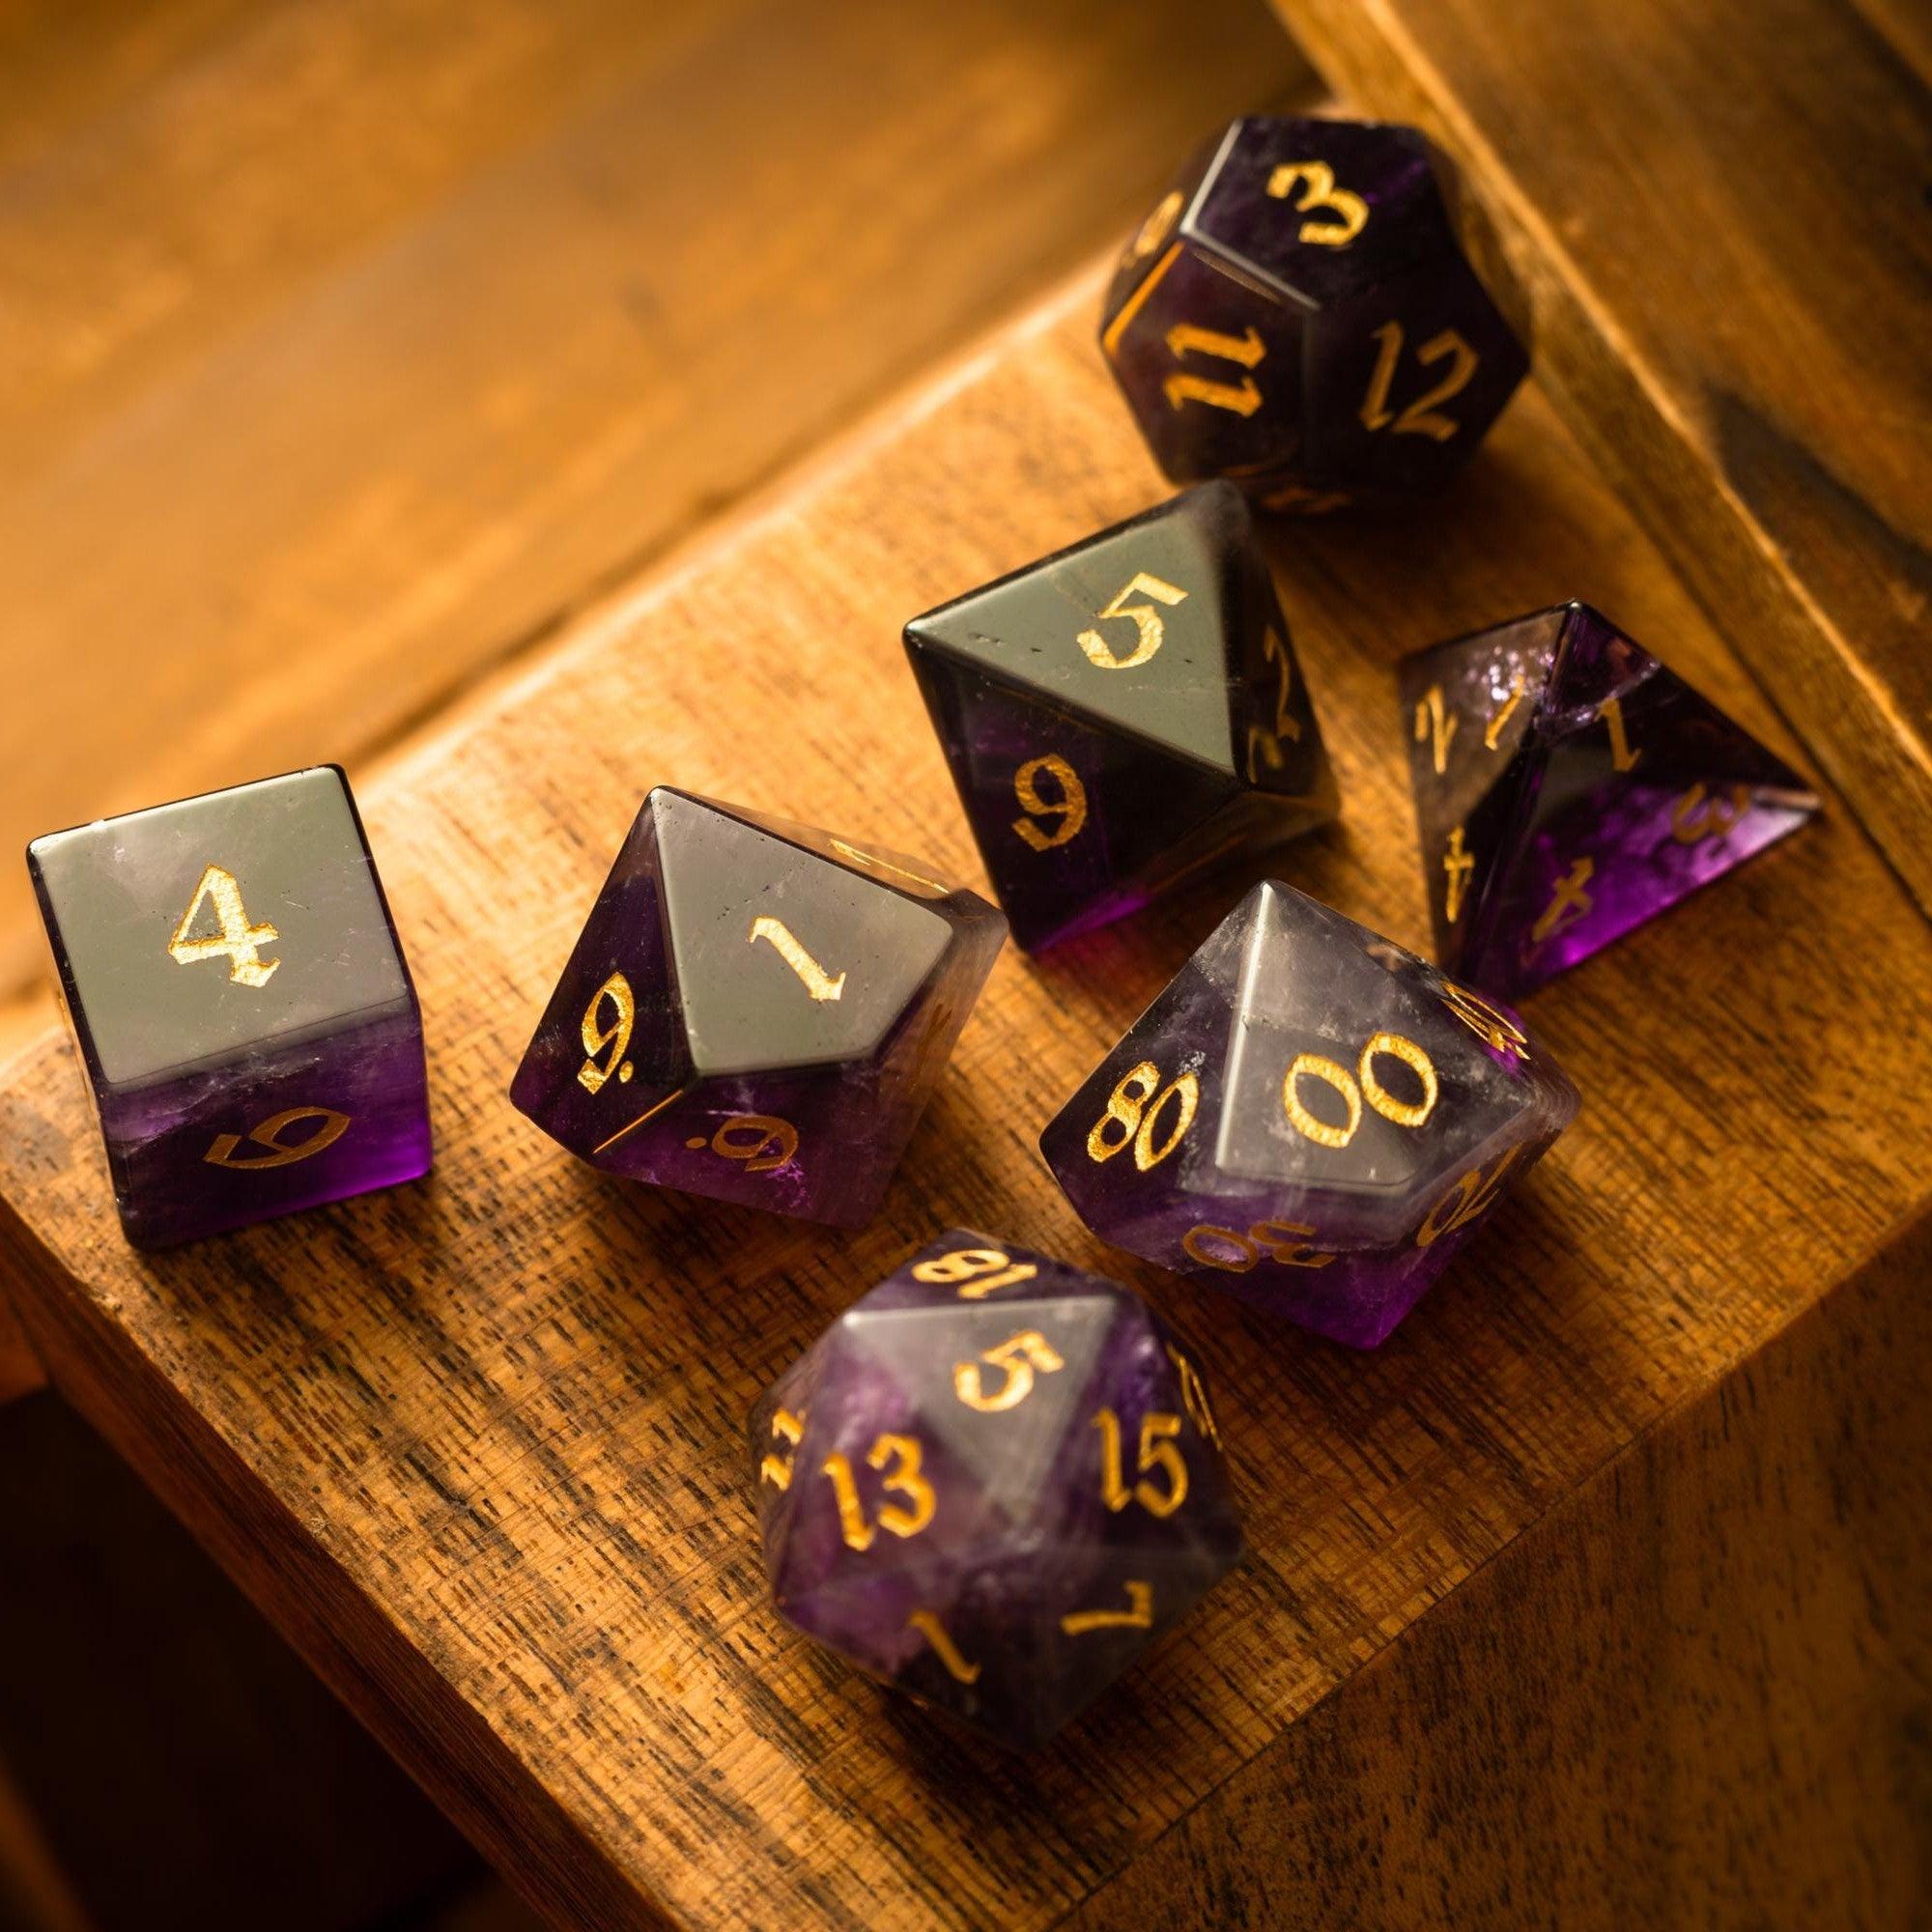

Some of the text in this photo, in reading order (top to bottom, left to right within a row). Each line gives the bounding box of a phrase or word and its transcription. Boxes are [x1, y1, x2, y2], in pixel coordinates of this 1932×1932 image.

[1266, 160, 1369, 249] 3
[1164, 323, 1266, 417] 11
[1359, 320, 1479, 441] 12
[1076, 572, 1189, 669] 5
[168, 864, 281, 988] 4
[747, 916, 846, 1003] 1
[1087, 1061, 1199, 1173] 80
[1283, 1031, 1438, 1149] 00
[953, 1329, 1065, 1413] 5
[821, 1433, 937, 1552] 13
[1092, 1406, 1189, 1518] 15
[909, 1610, 982, 1684] 1
